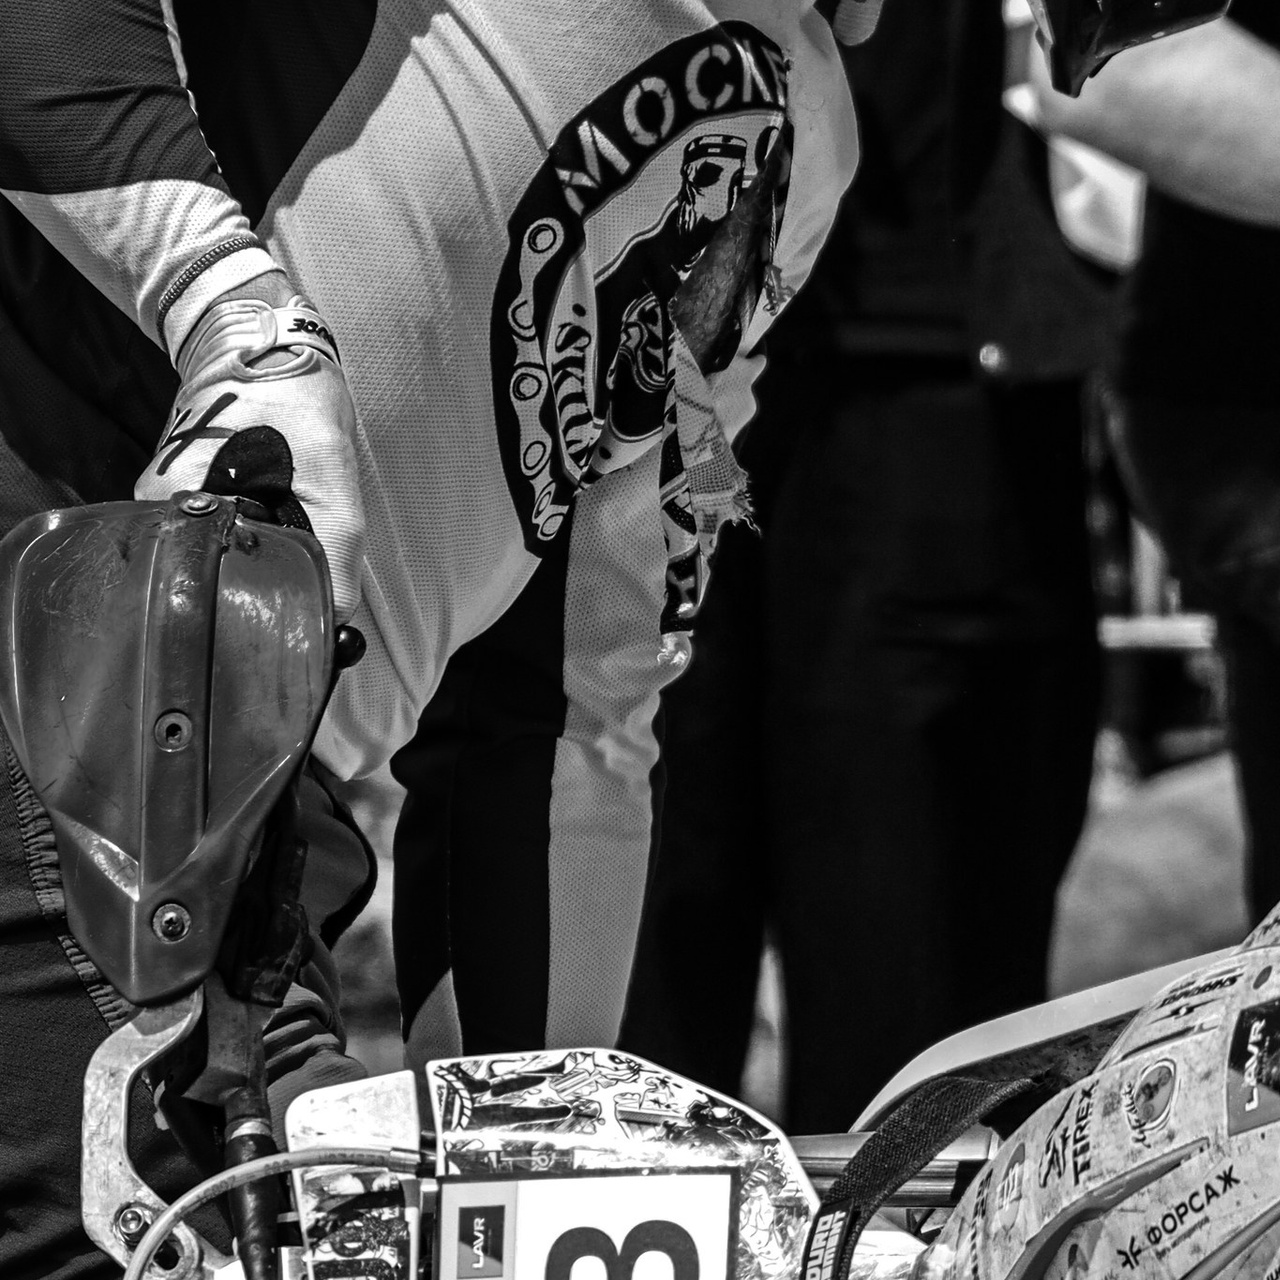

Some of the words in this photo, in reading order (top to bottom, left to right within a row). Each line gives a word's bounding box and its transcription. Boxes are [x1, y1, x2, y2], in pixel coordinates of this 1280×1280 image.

[1242, 1018, 1267, 1112] LAVR
[470, 1216, 485, 1270] LAVR
[1146, 1165, 1240, 1245] ФОРСАЖ
